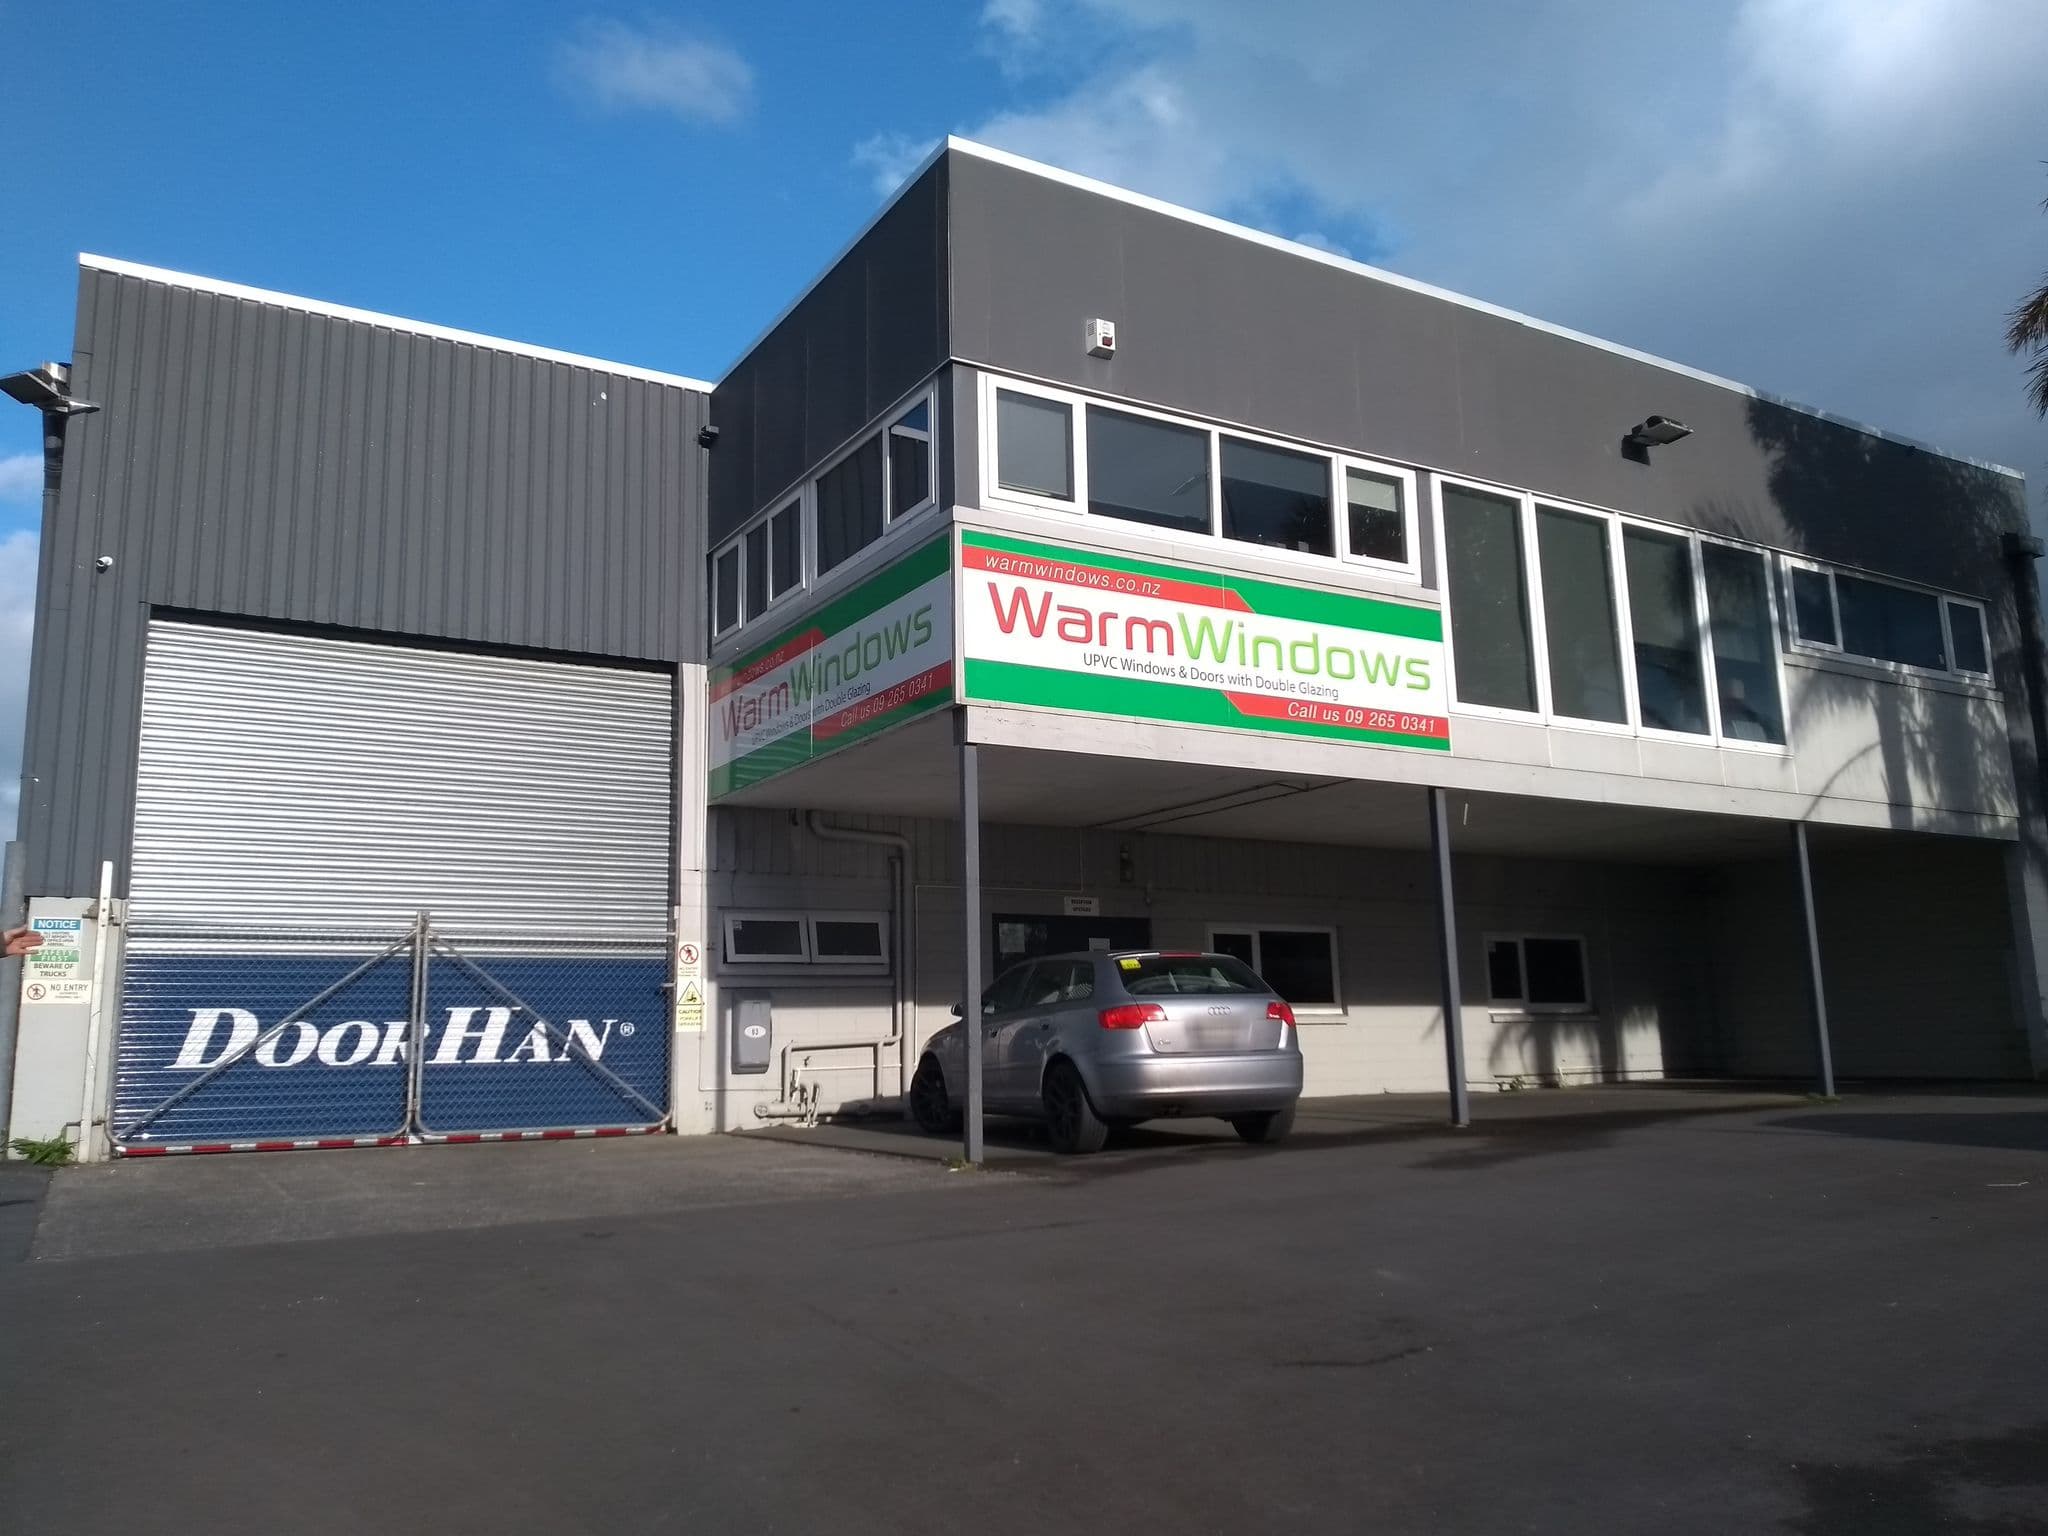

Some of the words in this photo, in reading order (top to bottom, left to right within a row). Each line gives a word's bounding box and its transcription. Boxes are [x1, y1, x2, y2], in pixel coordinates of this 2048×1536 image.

[985, 554, 1161, 595] warmwindows.co.nz
[987, 581, 1431, 690] WarmWindows
[722, 603, 932, 741] WarmWindows
[847, 682, 871, 700] Glazing
[1083, 652, 1118, 670] UPVC
[1120, 657, 1176, 678] Windows
[1178, 665, 1187, 679] &
[1190, 667, 1225, 684] Doors
[1227, 673, 1253, 687] with
[1256, 676, 1296, 693] Double
[1298, 681, 1339, 701] Glazing
[841, 707, 857, 727] Call
[860, 704, 871, 719] us
[873, 695, 884, 713] 09
[887, 685, 905, 707] 265
[909, 673, 933, 697] 0341
[1288, 701, 1317, 719] Call
[1323, 709, 1340, 722] us
[1345, 708, 1363, 724] 09
[1368, 711, 1395, 728] 265
[1401, 715, 1435, 733] 0341
[38, 919, 77, 929] NOTICE
